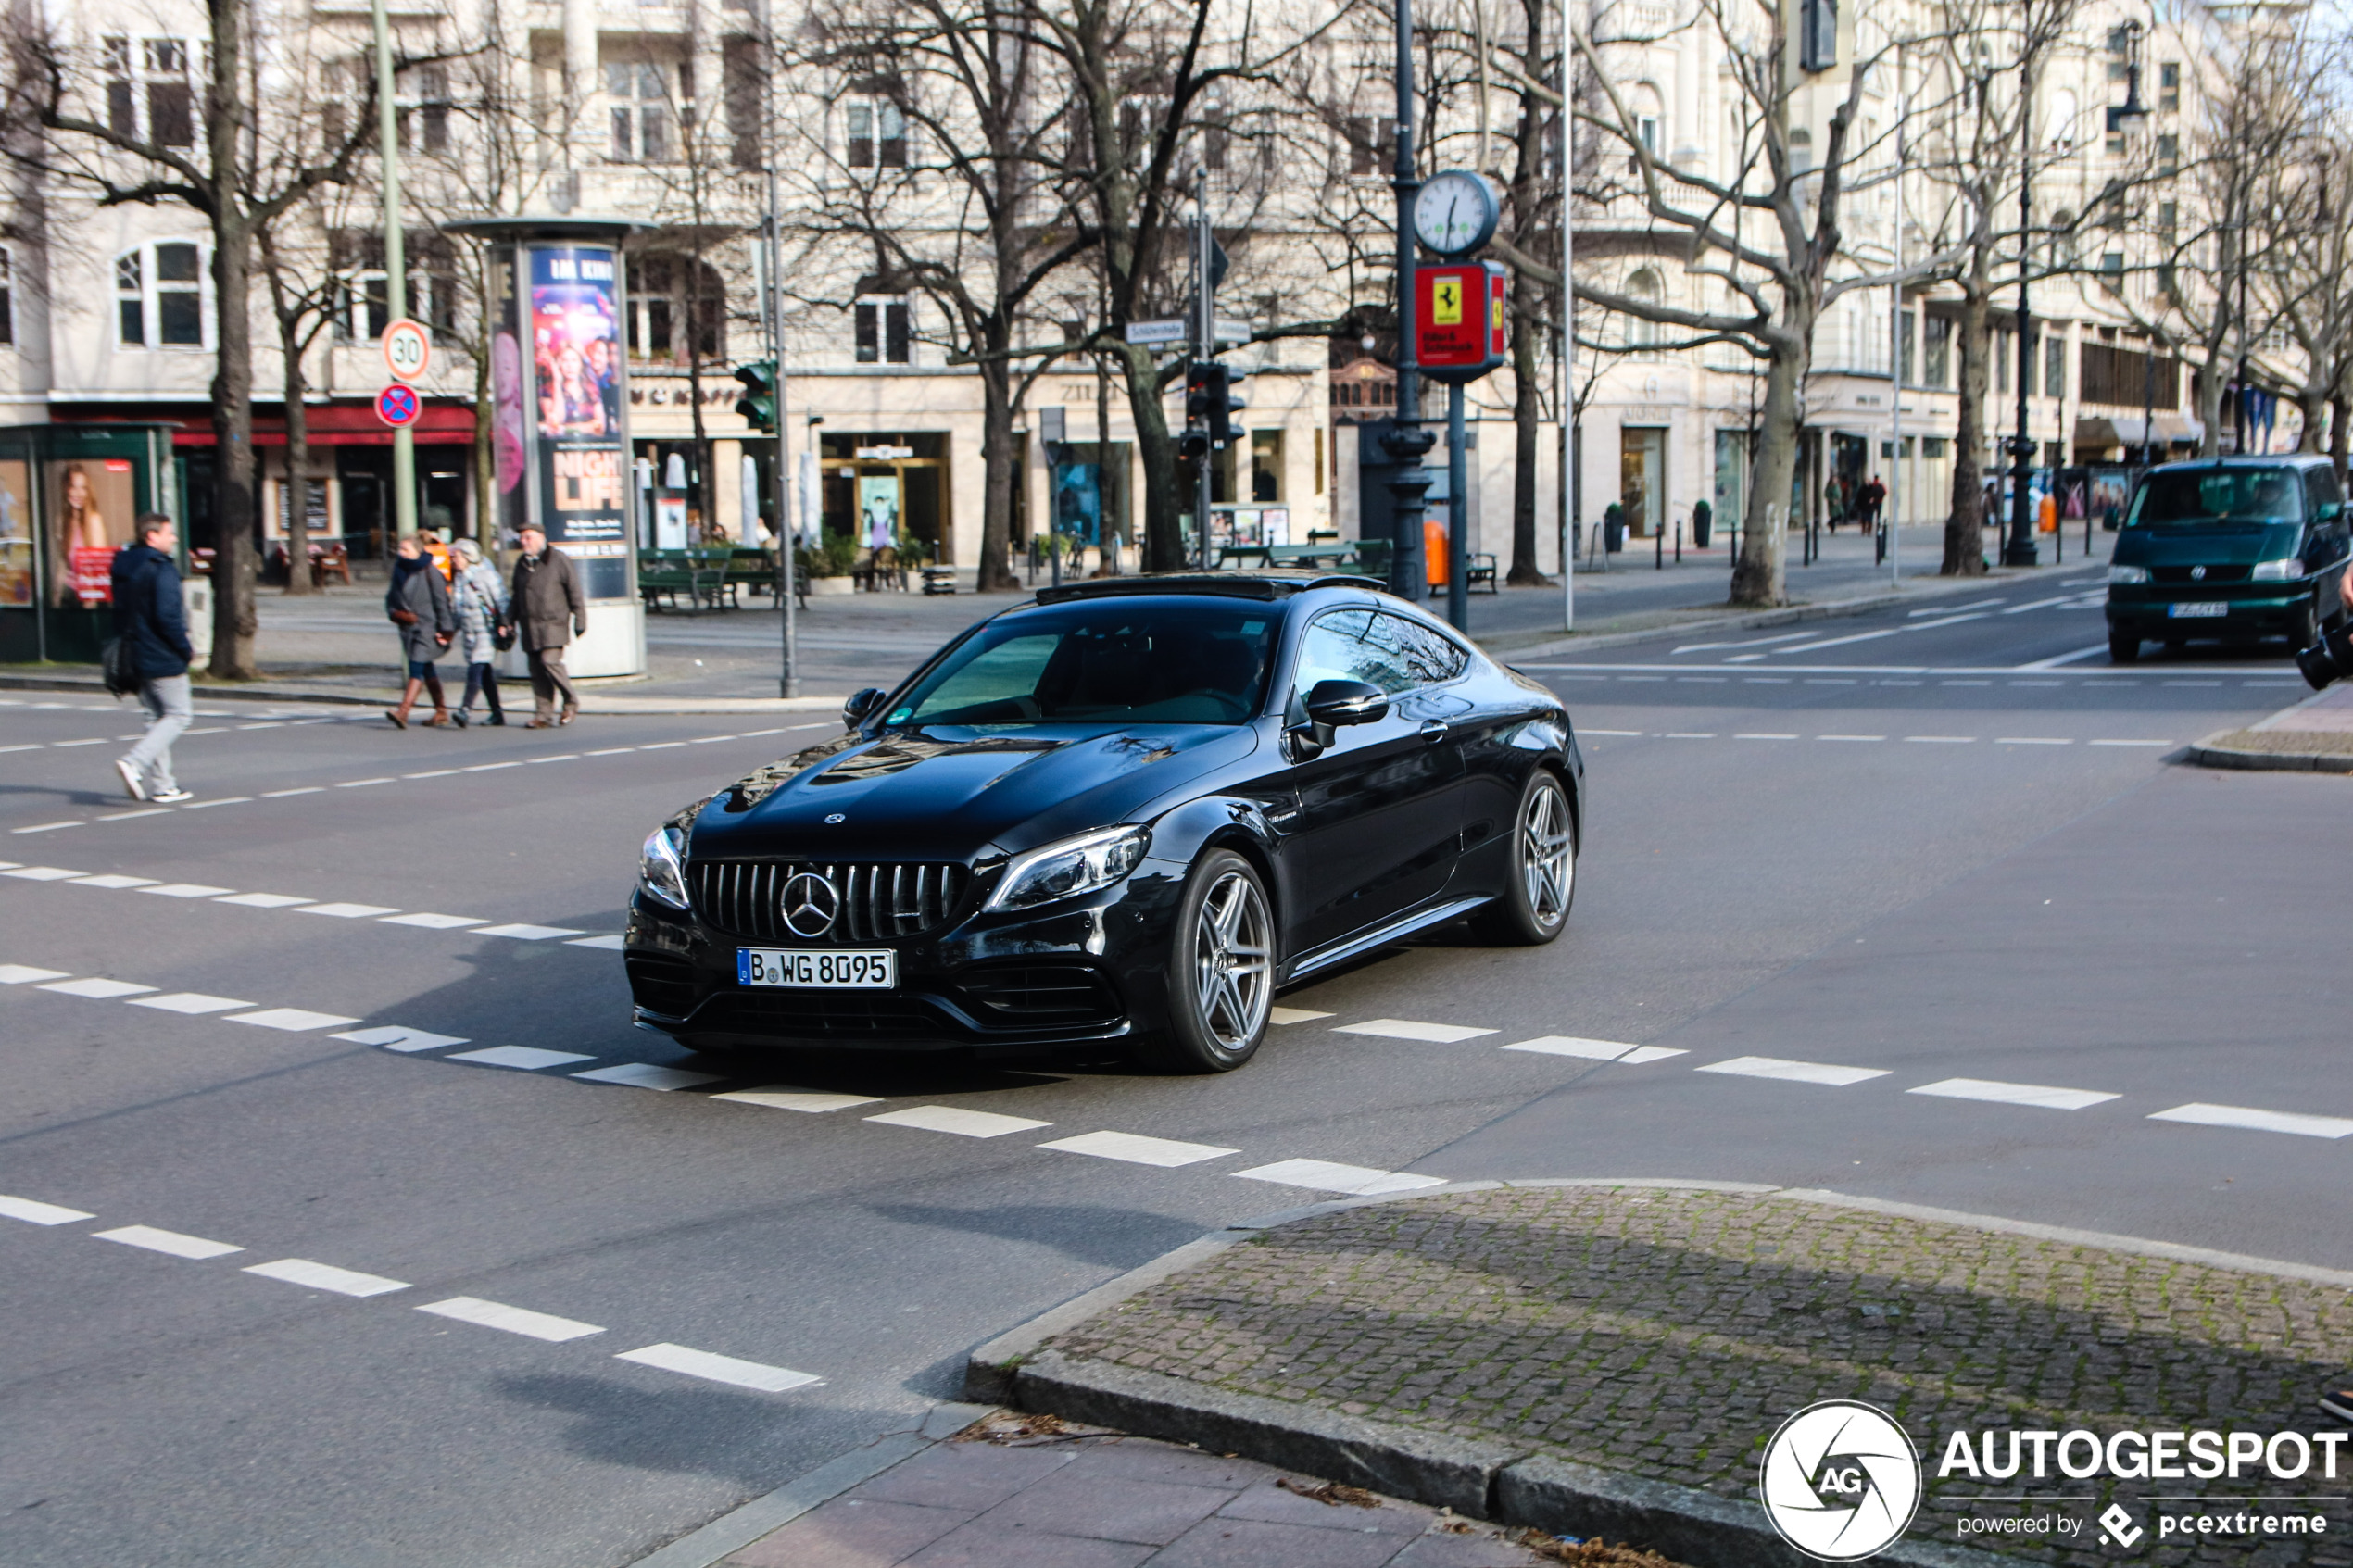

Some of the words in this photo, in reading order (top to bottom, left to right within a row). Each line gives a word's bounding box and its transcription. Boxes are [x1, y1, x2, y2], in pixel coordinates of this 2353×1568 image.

[550, 259, 578, 280] IM
[394, 337, 418, 363] 30
[555, 477, 623, 510] LIFE
[751, 953, 765, 981] B
[781, 955, 812, 983] WG
[819, 955, 887, 984] 8095
